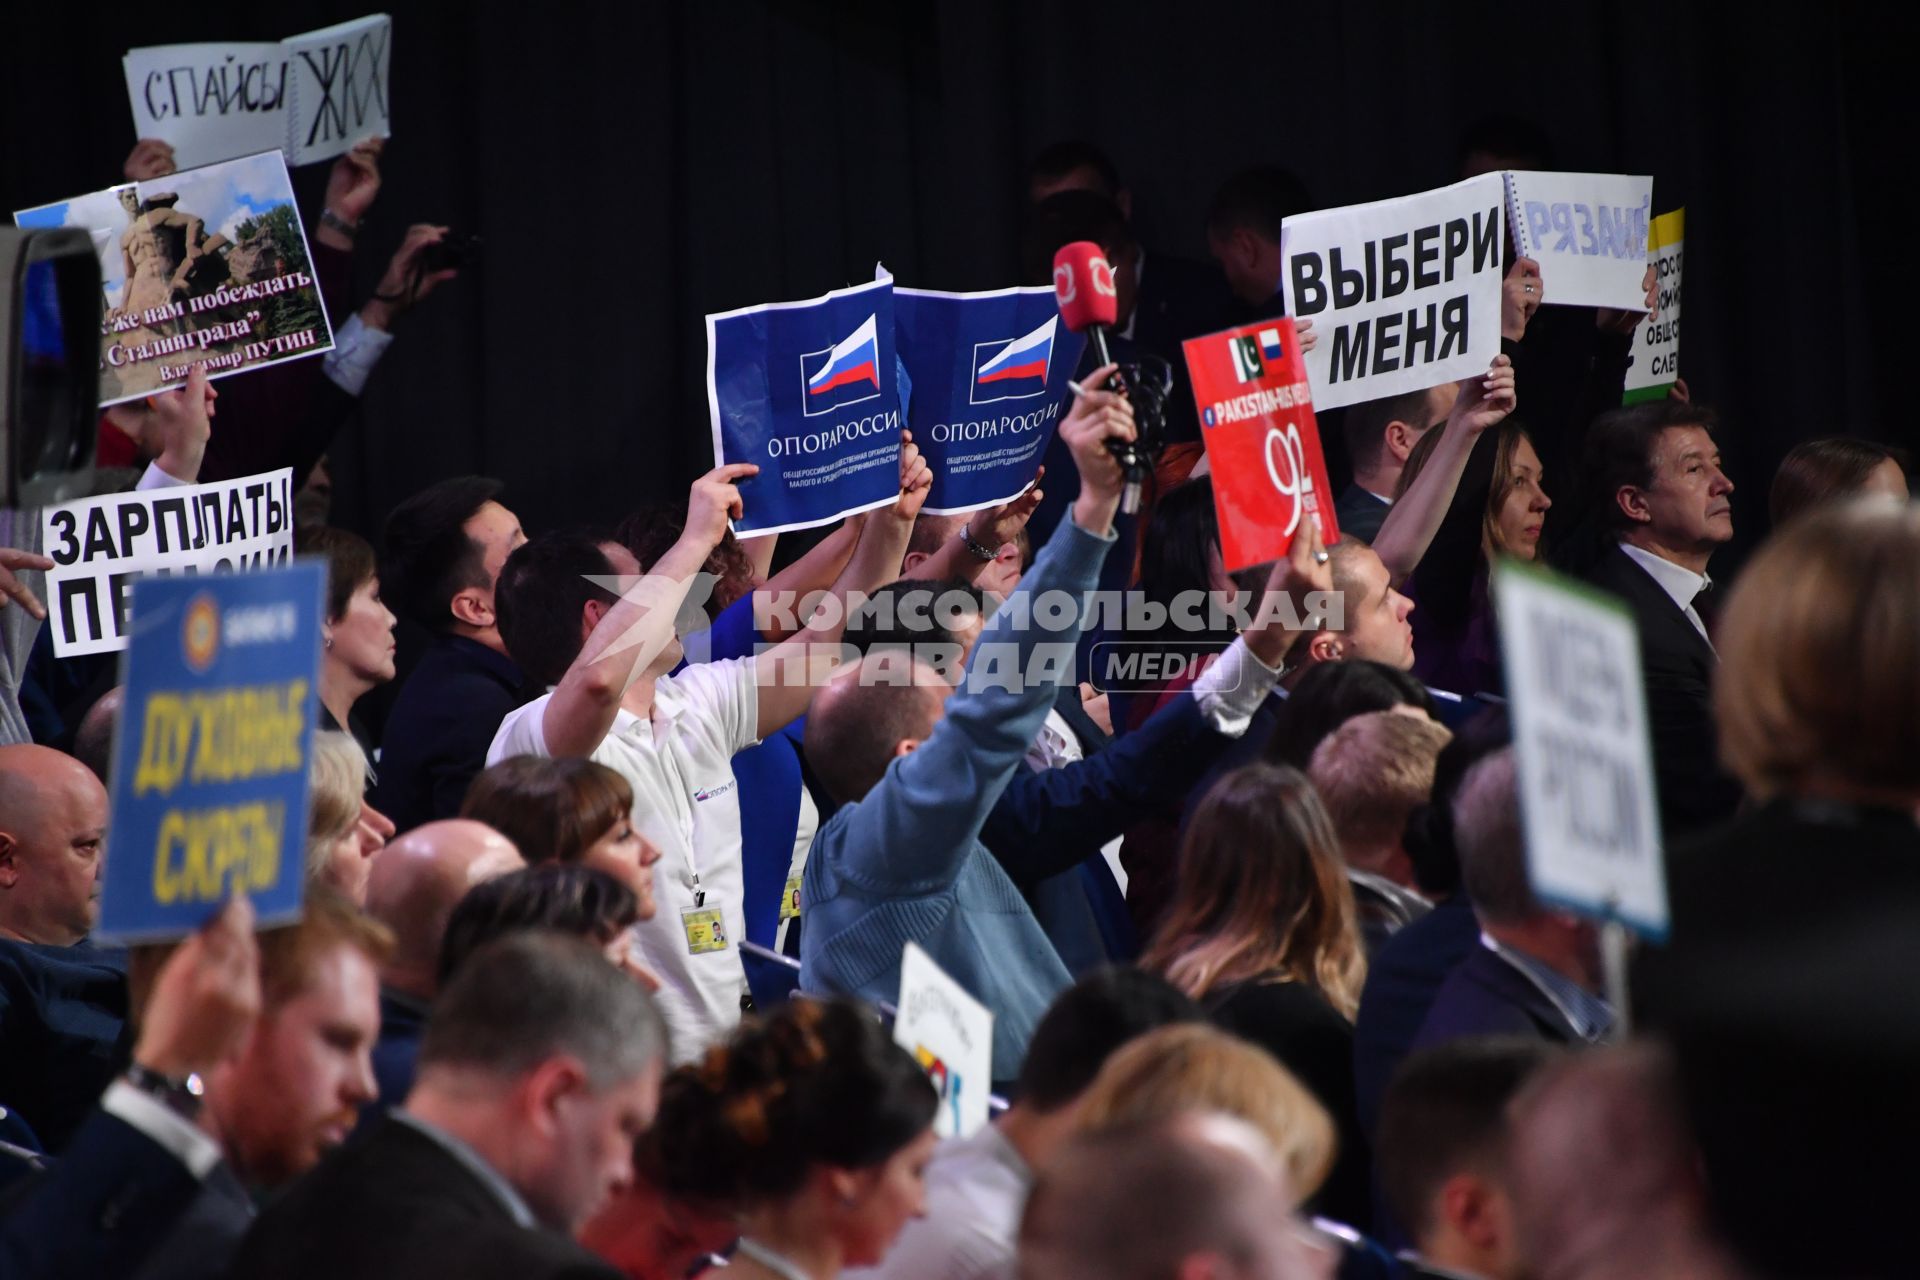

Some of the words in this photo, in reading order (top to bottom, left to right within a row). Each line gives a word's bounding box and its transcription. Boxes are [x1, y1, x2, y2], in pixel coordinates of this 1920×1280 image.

[145, 54, 288, 121] СПАЙСЫ
[298, 24, 388, 147] ЖКХ
[143, 300, 184, 326] нам
[188, 270, 311, 314] побеждать
[1291, 206, 1499, 317] ВЫБЕРИ
[244, 328, 316, 361] ПУТИН
[1329, 294, 1469, 385] МЕНЯ
[50, 477, 291, 567] ЗАРПЛАТЫ
